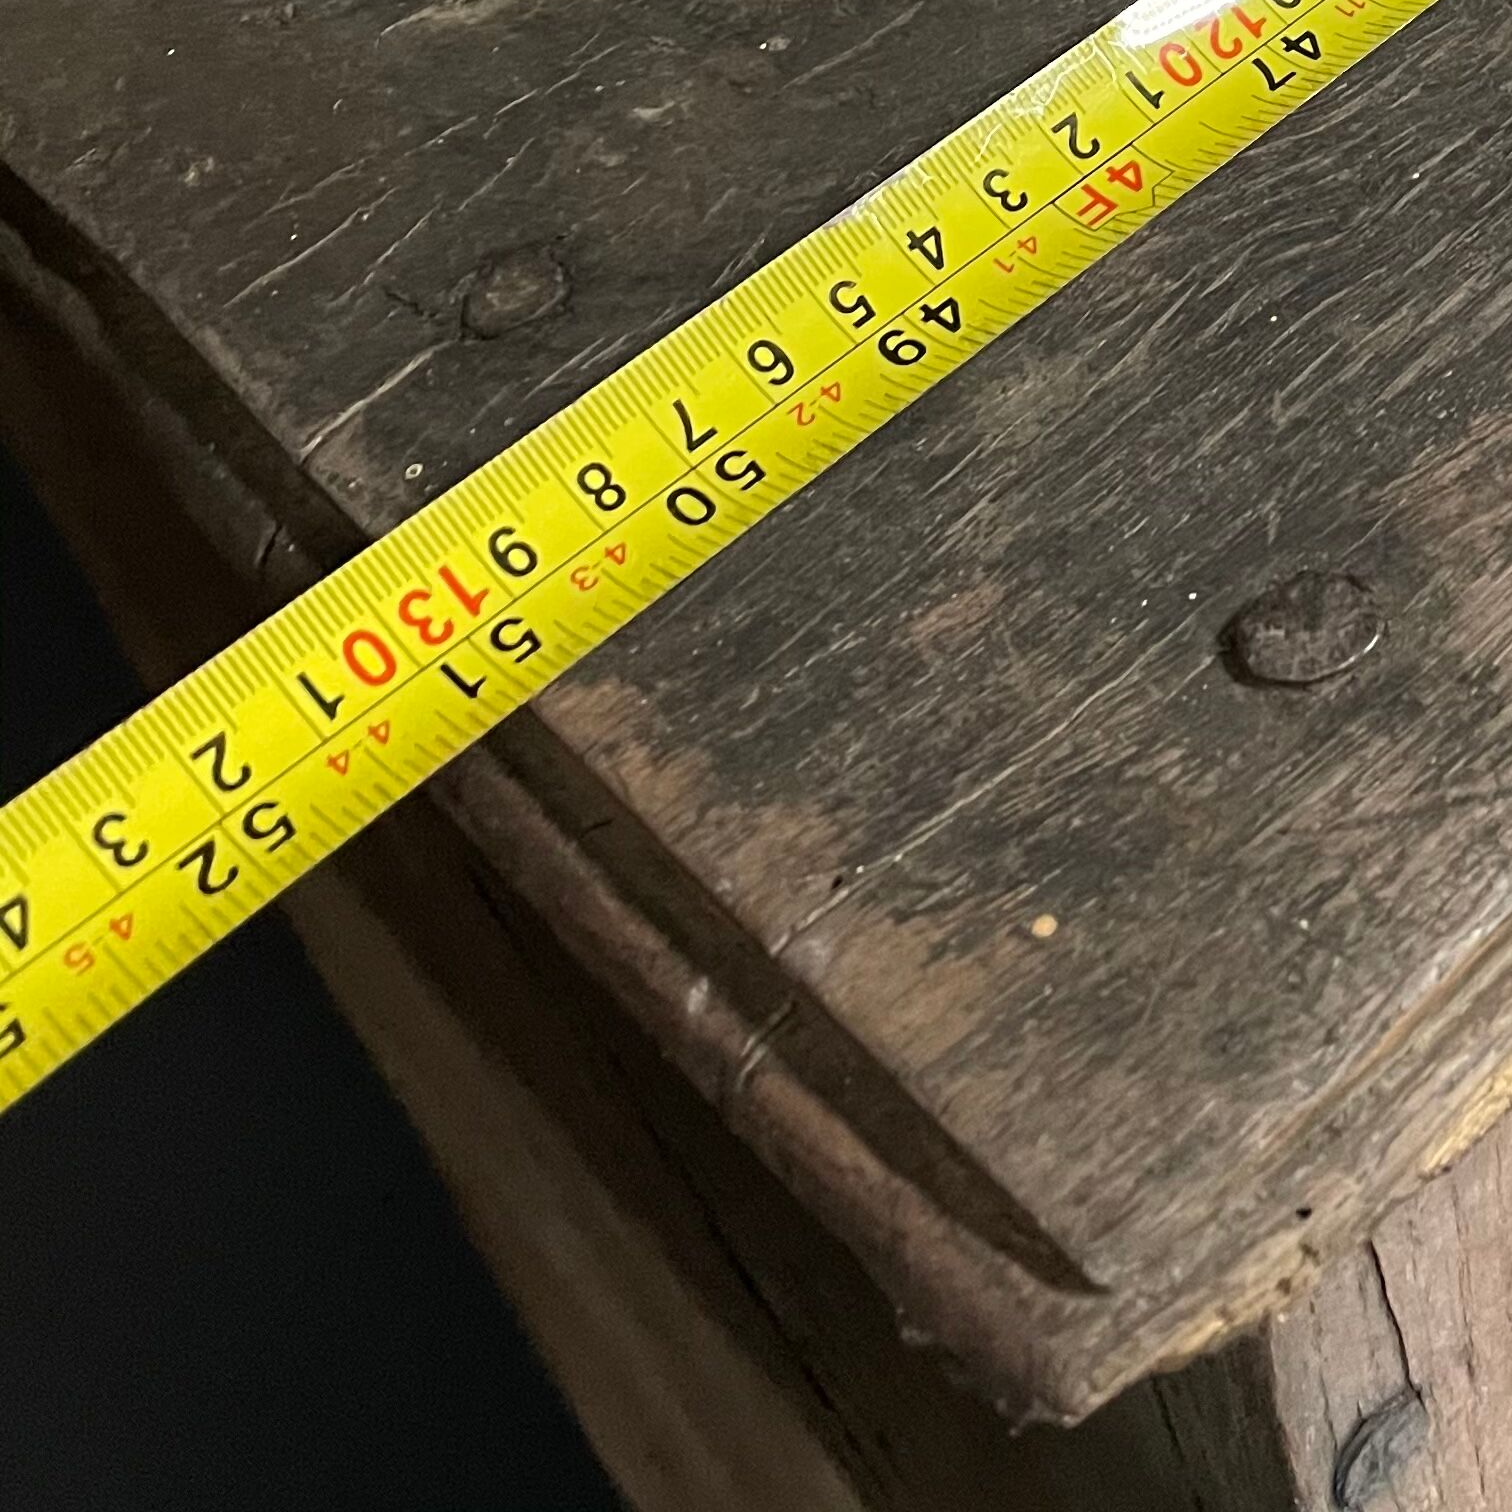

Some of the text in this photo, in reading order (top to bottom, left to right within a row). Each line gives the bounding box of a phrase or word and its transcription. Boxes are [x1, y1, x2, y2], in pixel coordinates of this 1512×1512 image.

[1158, 6, 1268, 89] 120
[1250, 29, 1323, 93] 47
[1125, 70, 1164, 110] 1
[1051, 112, 1101, 161] 2
[982, 168, 1029, 213] 3
[1076, 160, 1146, 228] 4F
[905, 226, 946, 271] 4
[993, 234, 1039, 274] 4-1
[828, 280, 877, 329] 5
[876, 296, 963, 367] 49
[746, 339, 796, 387] 6
[672, 399, 719, 454] 7
[788, 380, 843, 427] 4-2
[576, 461, 627, 513] 8
[665, 449, 768, 527] 50
[487, 526, 539, 578] 9
[569, 540, 629, 592] 4-3
[341, 565, 490, 688] 130
[439, 617, 543, 700] 51
[297, 673, 345, 722] 1
[191, 733, 252, 793] 2
[325, 720, 392, 778] 4-4
[93, 813, 149, 868] 3
[177, 801, 297, 896] 52
[62, 913, 134, 976] 4-5
